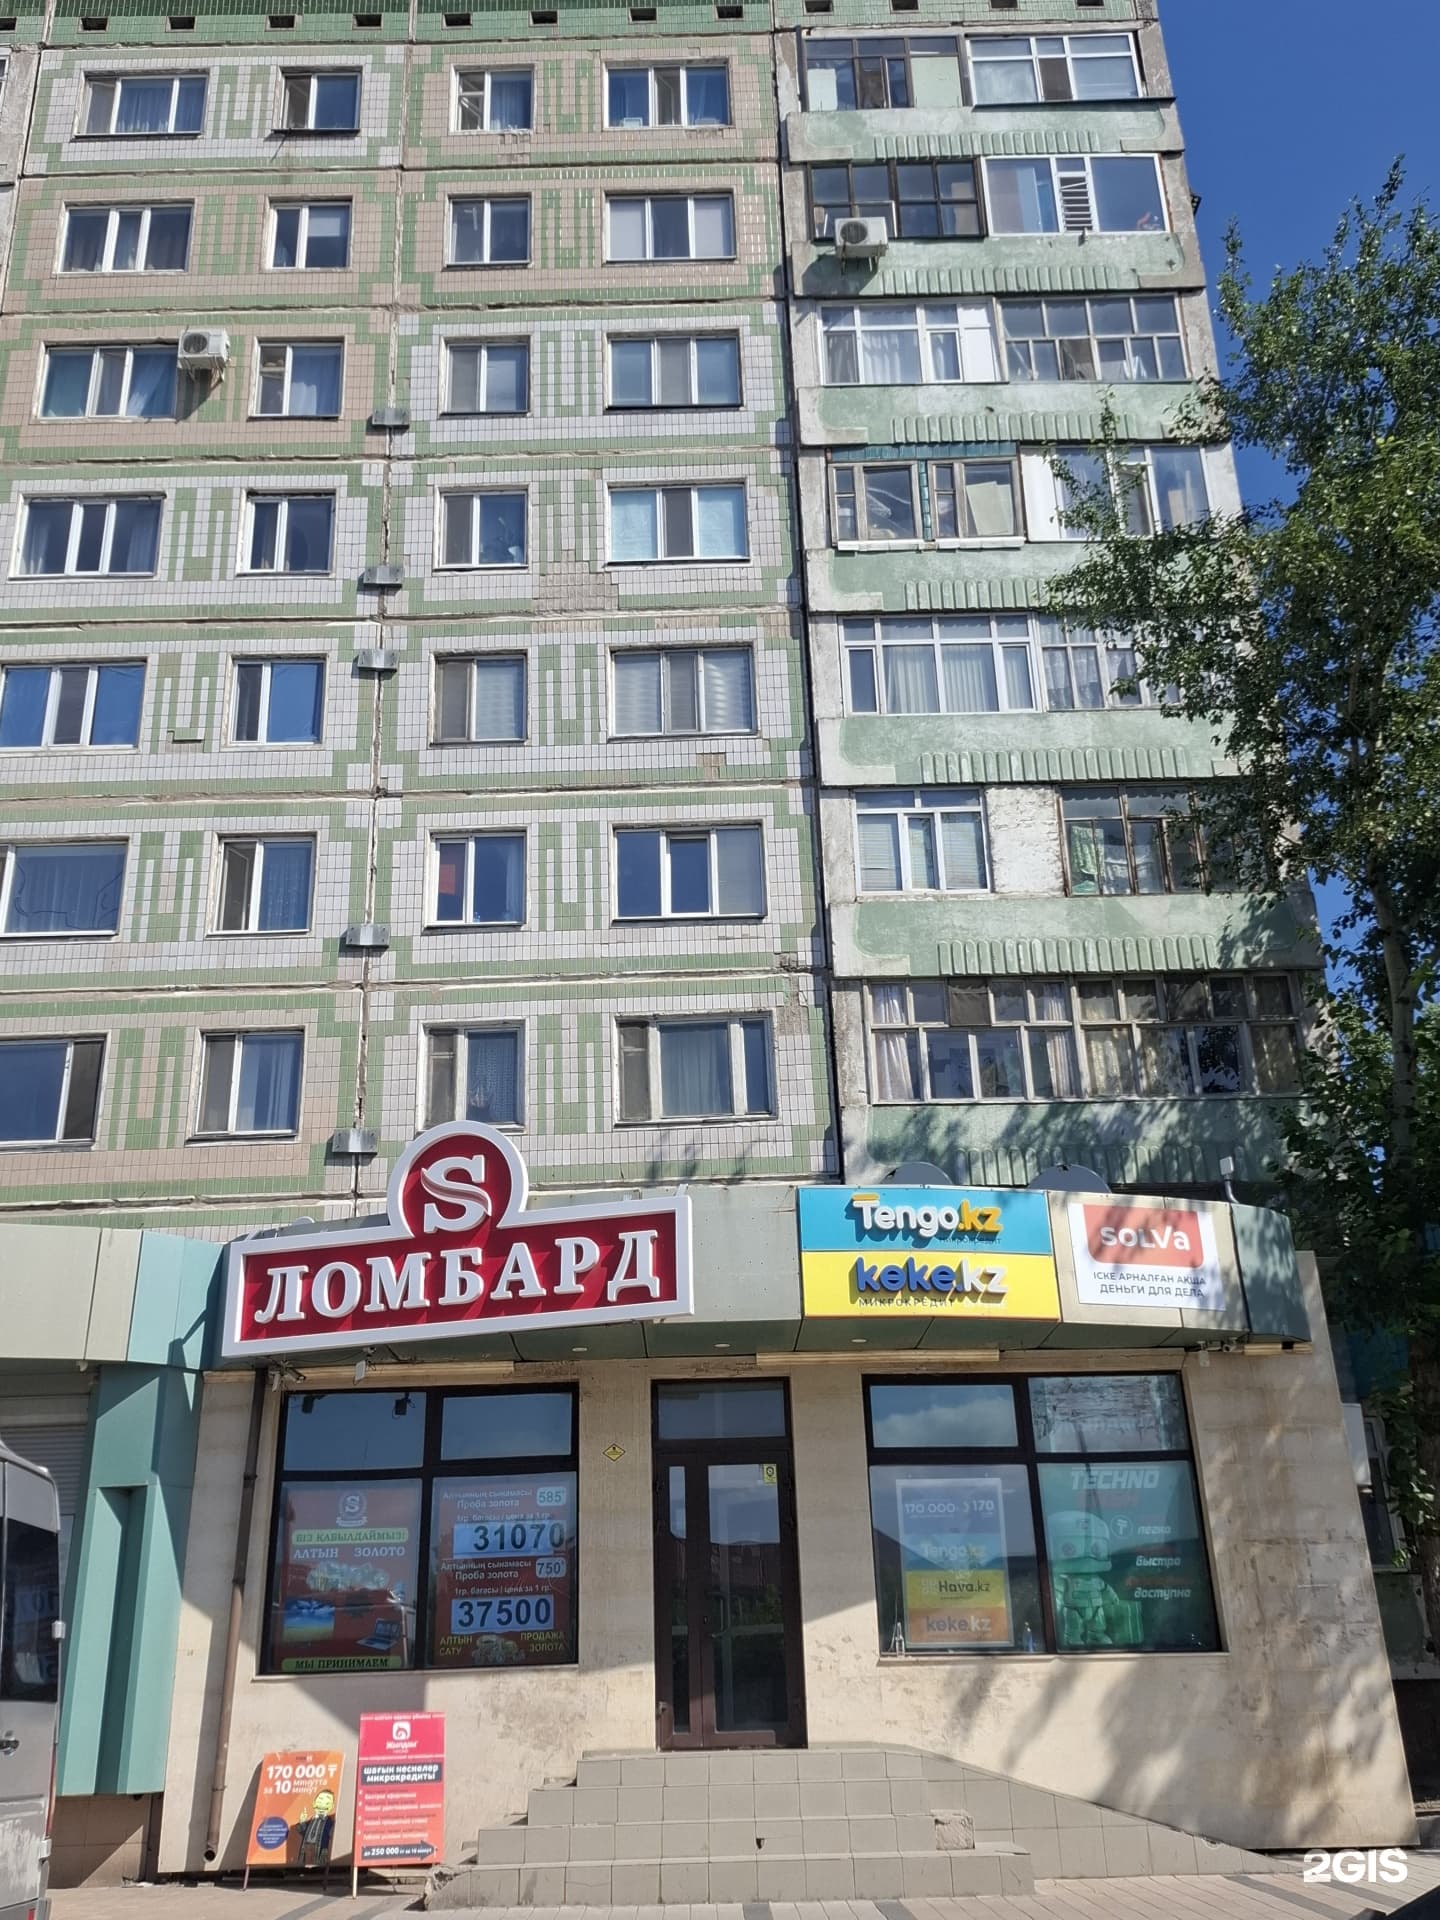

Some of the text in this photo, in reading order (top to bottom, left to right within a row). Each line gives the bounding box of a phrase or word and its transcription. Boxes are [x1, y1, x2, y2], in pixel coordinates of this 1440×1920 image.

[421, 1154, 492, 1234] S
[852, 1193, 1003, 1238] Tengo.kz
[254, 1229, 660, 1324] ЛОМБАРД
[1100, 1283, 1205, 1298] ДЕНЬГИ ДЛЯ ДЕЛА
[1070, 1467, 1161, 1490] TECHNO
[456, 1499, 520, 1510] Проба золота
[473, 1522, 565, 1551] 31070
[293, 1547, 339, 1560] АЛТЫН
[354, 1546, 406, 1558] ЗОЛОТО
[455, 1570, 520, 1582] Проба золота
[938, 1580, 991, 1593] Hava.kz
[458, 1597, 551, 1628] 37500
[439, 1635, 473, 1646] АЛТЫН
[520, 1631, 565, 1641] ПРОДАЖА
[295, 1658, 389, 1669] МЫ ПРИНИМАЕМ
[266, 1765, 293, 1779] 170
[295, 1764, 326, 1778] 000
[366, 1773, 436, 1784] микрокредиты
[274, 1781, 291, 1794] 10
